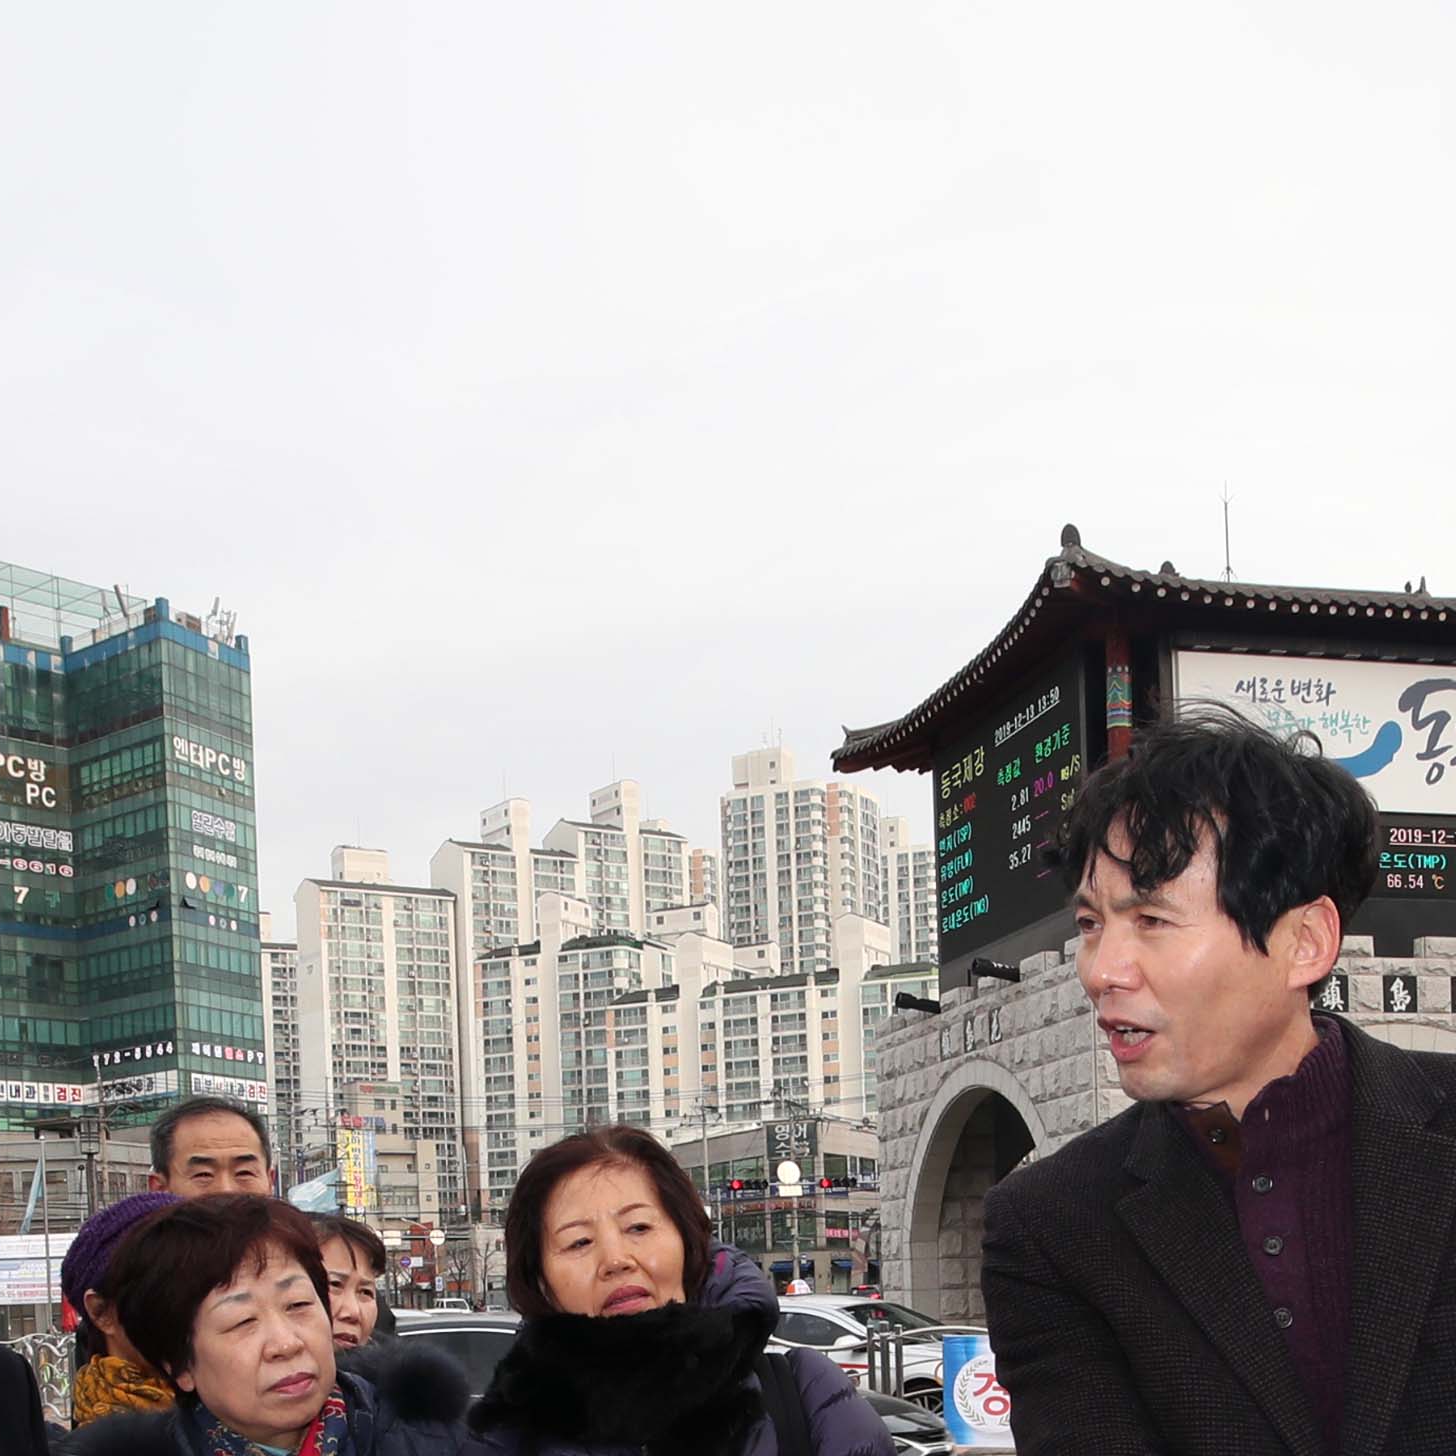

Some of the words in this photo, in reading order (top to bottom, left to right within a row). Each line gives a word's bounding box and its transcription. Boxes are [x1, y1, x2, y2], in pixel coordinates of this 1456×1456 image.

[1290, 675, 1337, 706] 변화
[1319, 709, 1371, 743] 행복한
[173, 736, 246, 782] 엔터PC방
[940, 746, 985, 799] 동국제강
[25, 782, 57, 808] PC
[1386, 873, 1424, 890] 66.54
[55, 1086, 82, 1102] 검진
[774, 1122, 808, 1140] 영어
